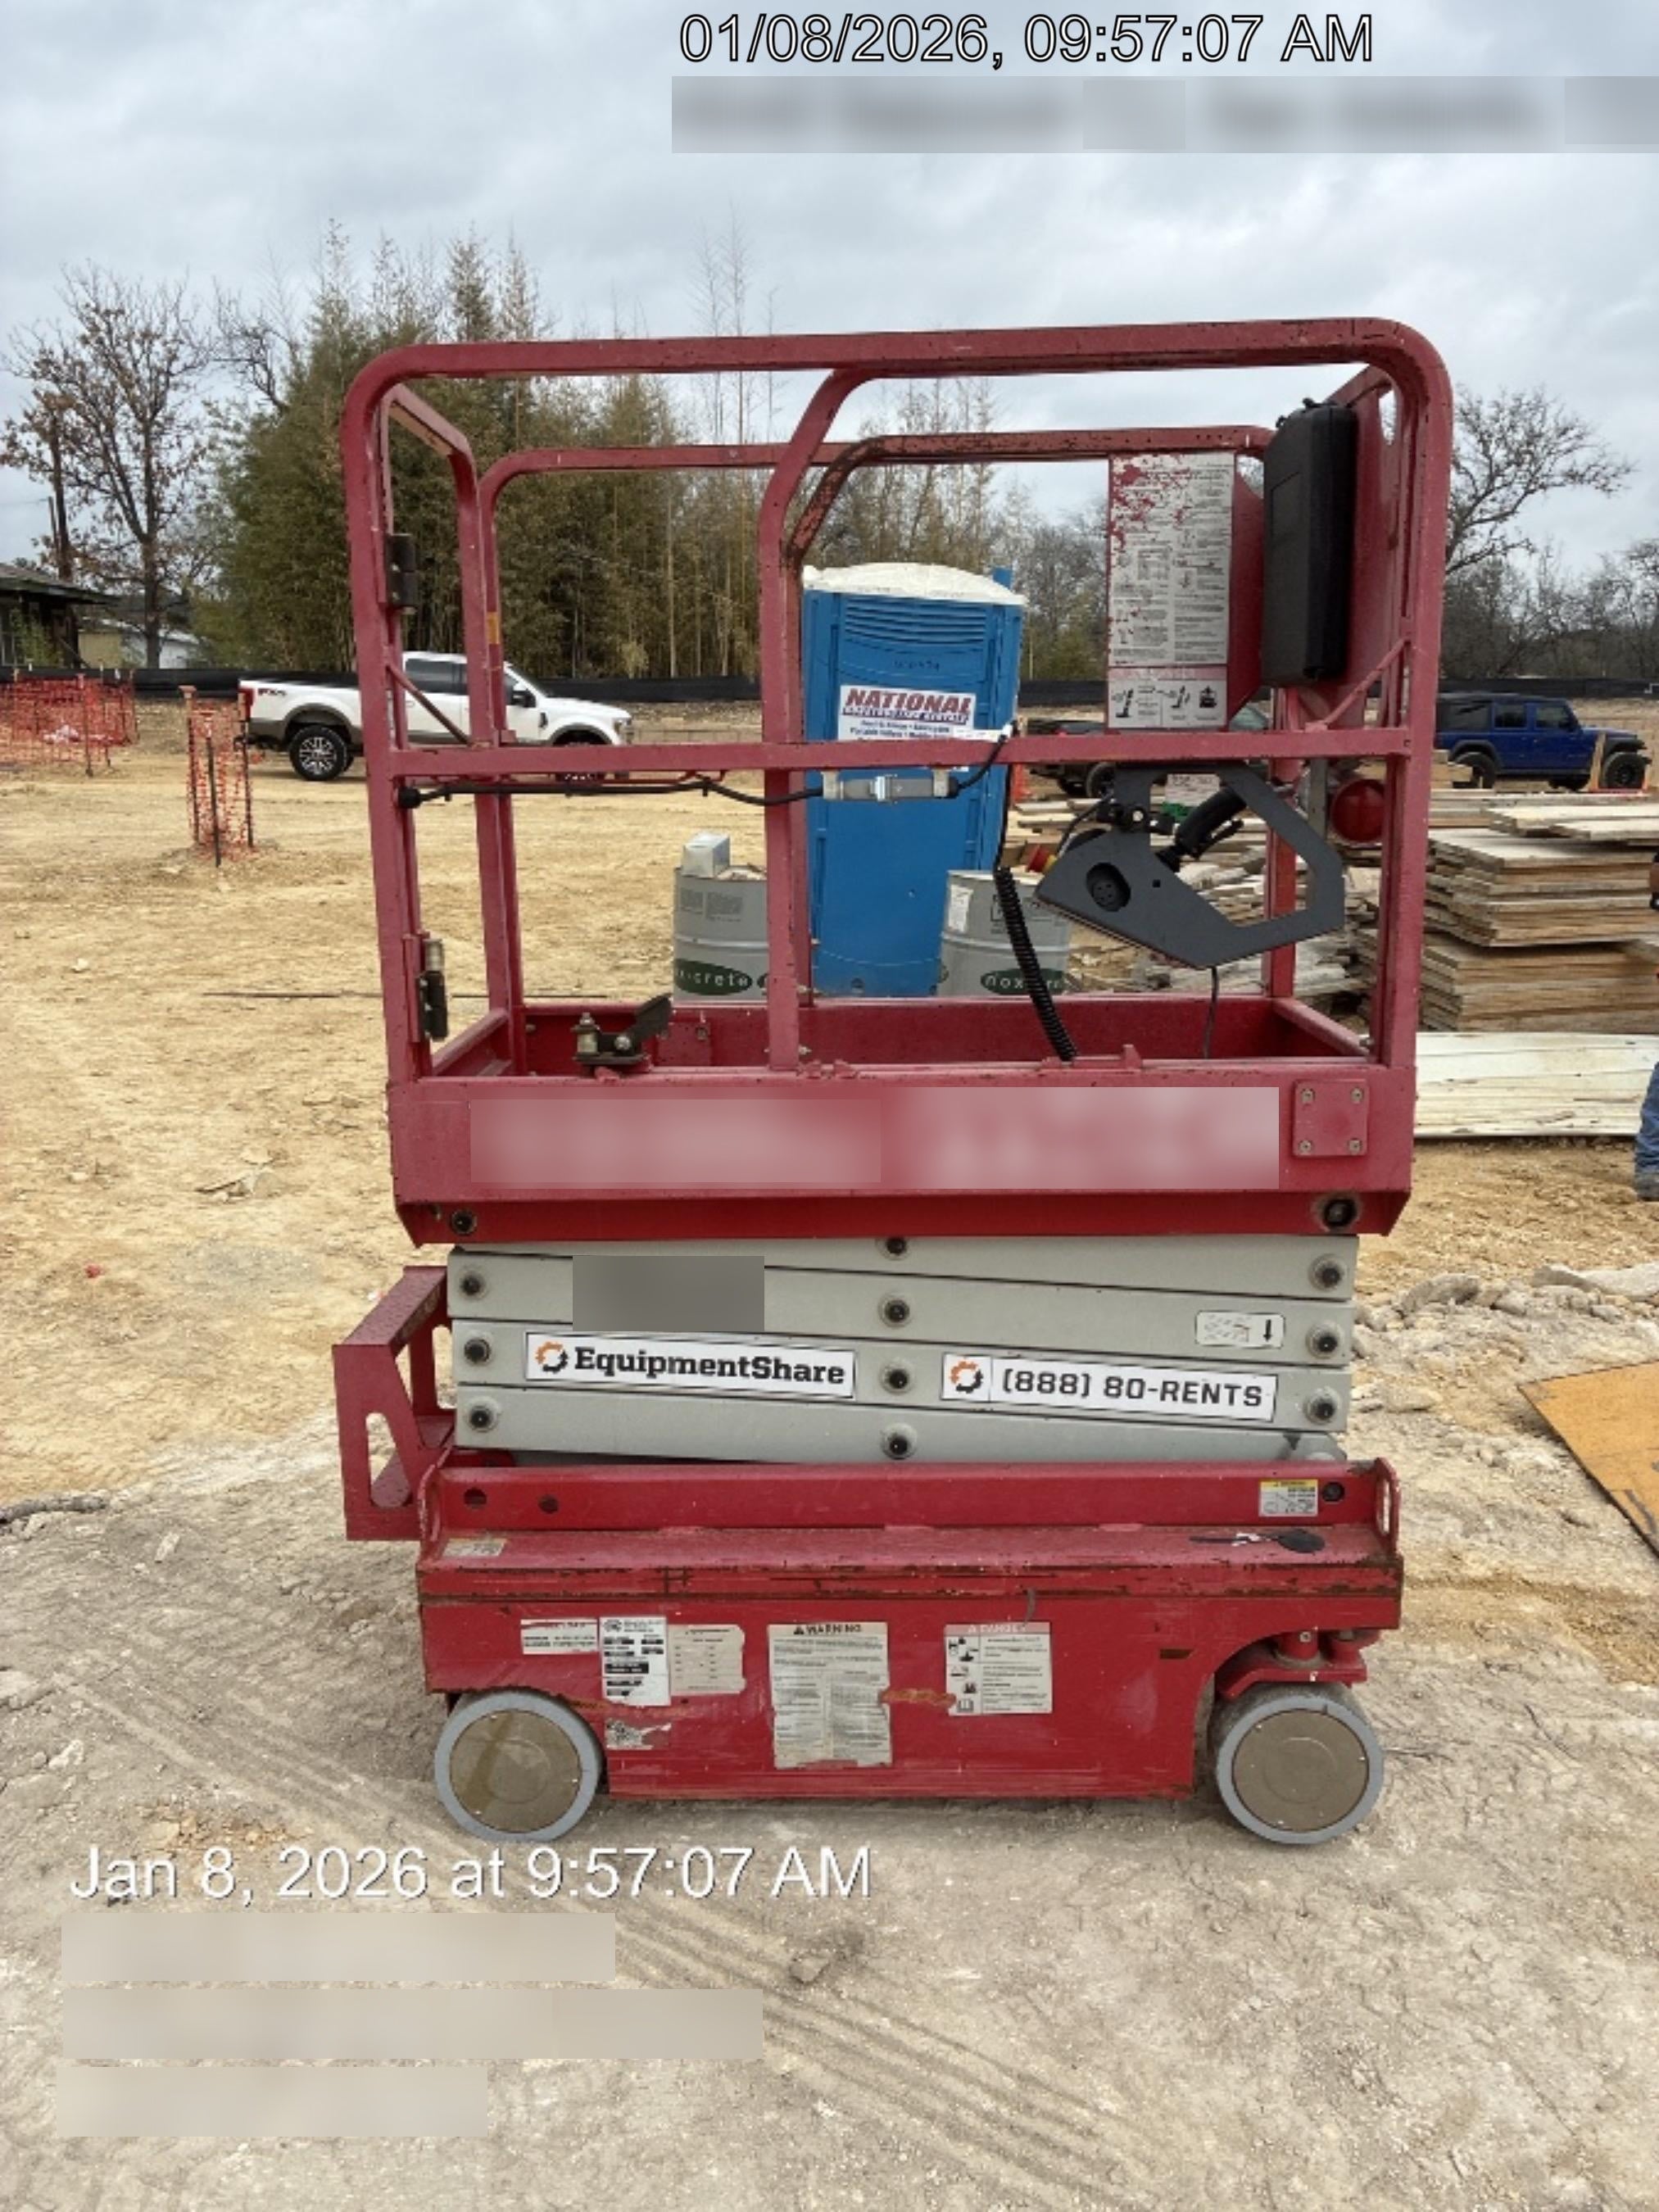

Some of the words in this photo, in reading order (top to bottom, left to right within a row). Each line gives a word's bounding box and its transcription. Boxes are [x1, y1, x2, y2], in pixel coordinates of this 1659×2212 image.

[845, 688, 972, 714] NATIONAL
[574, 1346, 845, 1385] EquipmentShare
[1002, 1368, 1091, 1398] (888)
[1103, 1375, 1262, 1407] 80-RENTS
